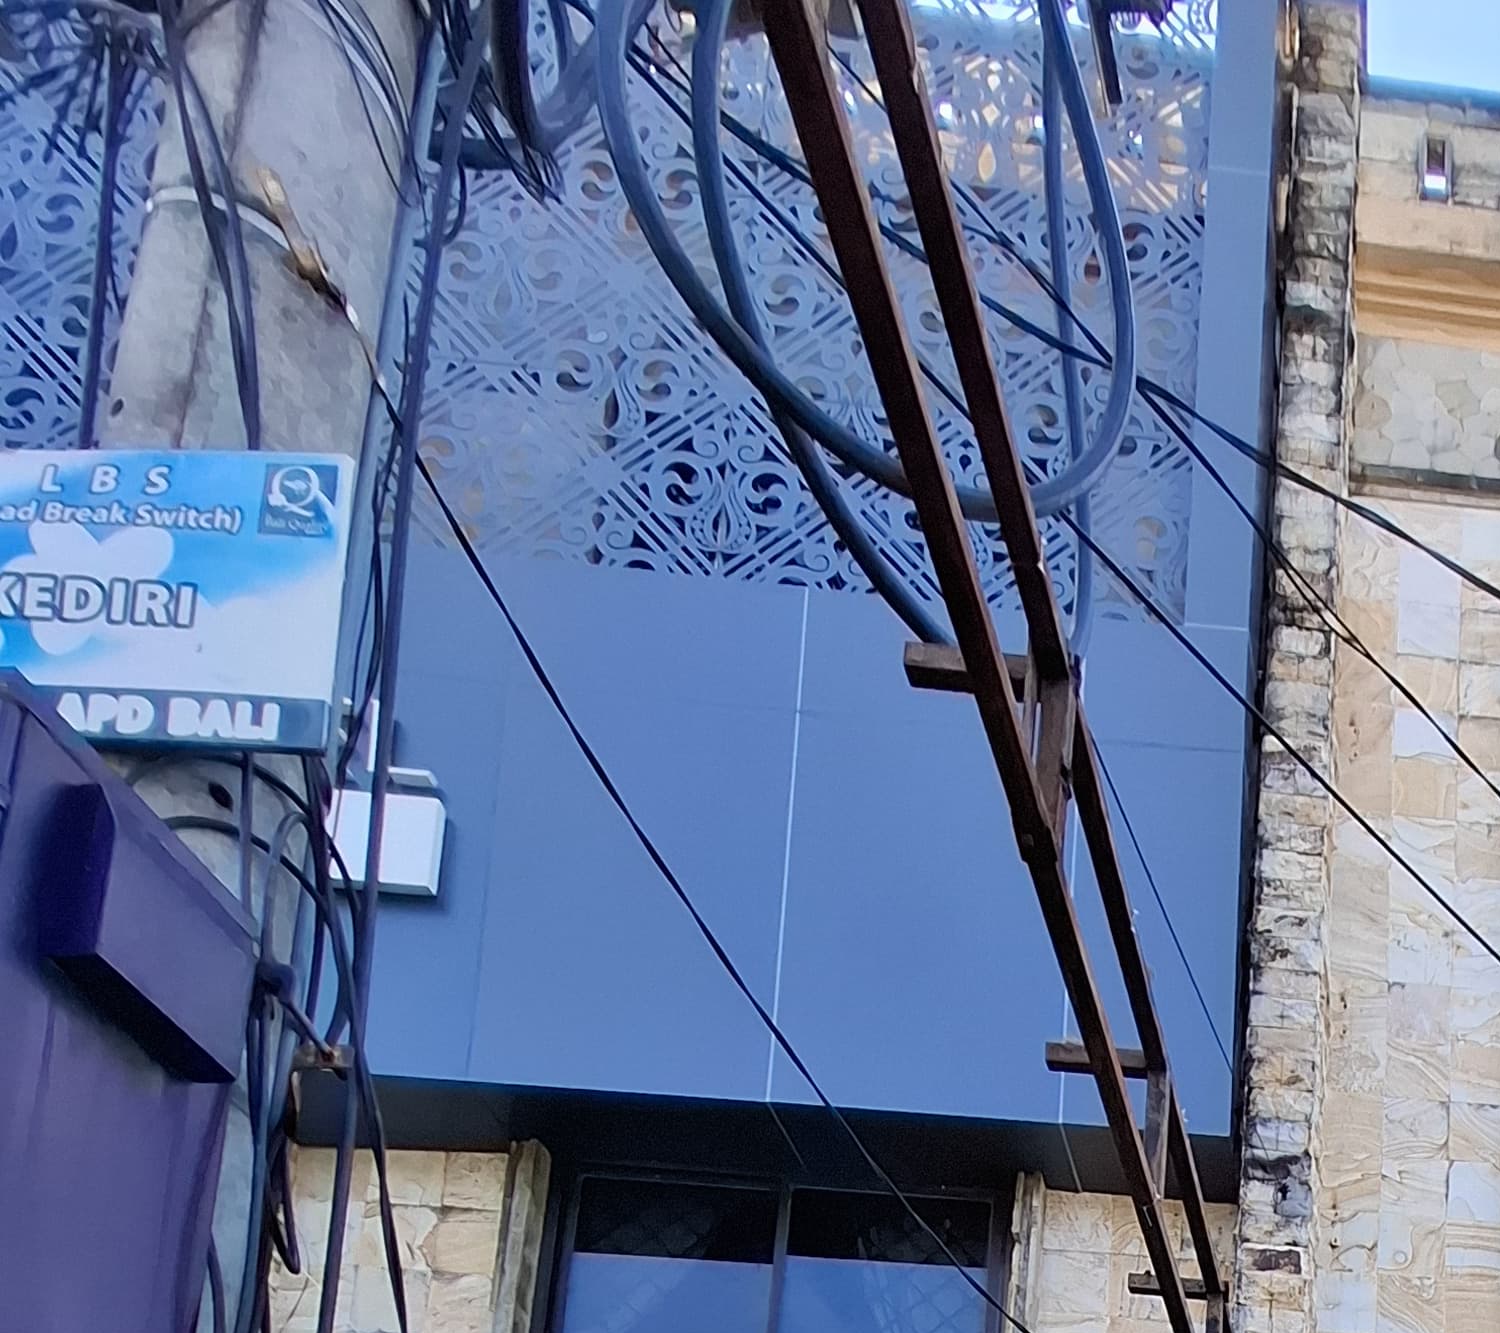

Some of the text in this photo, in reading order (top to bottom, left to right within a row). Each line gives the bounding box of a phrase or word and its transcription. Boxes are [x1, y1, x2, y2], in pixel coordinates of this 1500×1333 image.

[43, 501, 127, 525] Break
[135, 504, 243, 533] Switch)
[0, 572, 198, 628] KEDIRI
[167, 696, 280, 741] BALI
